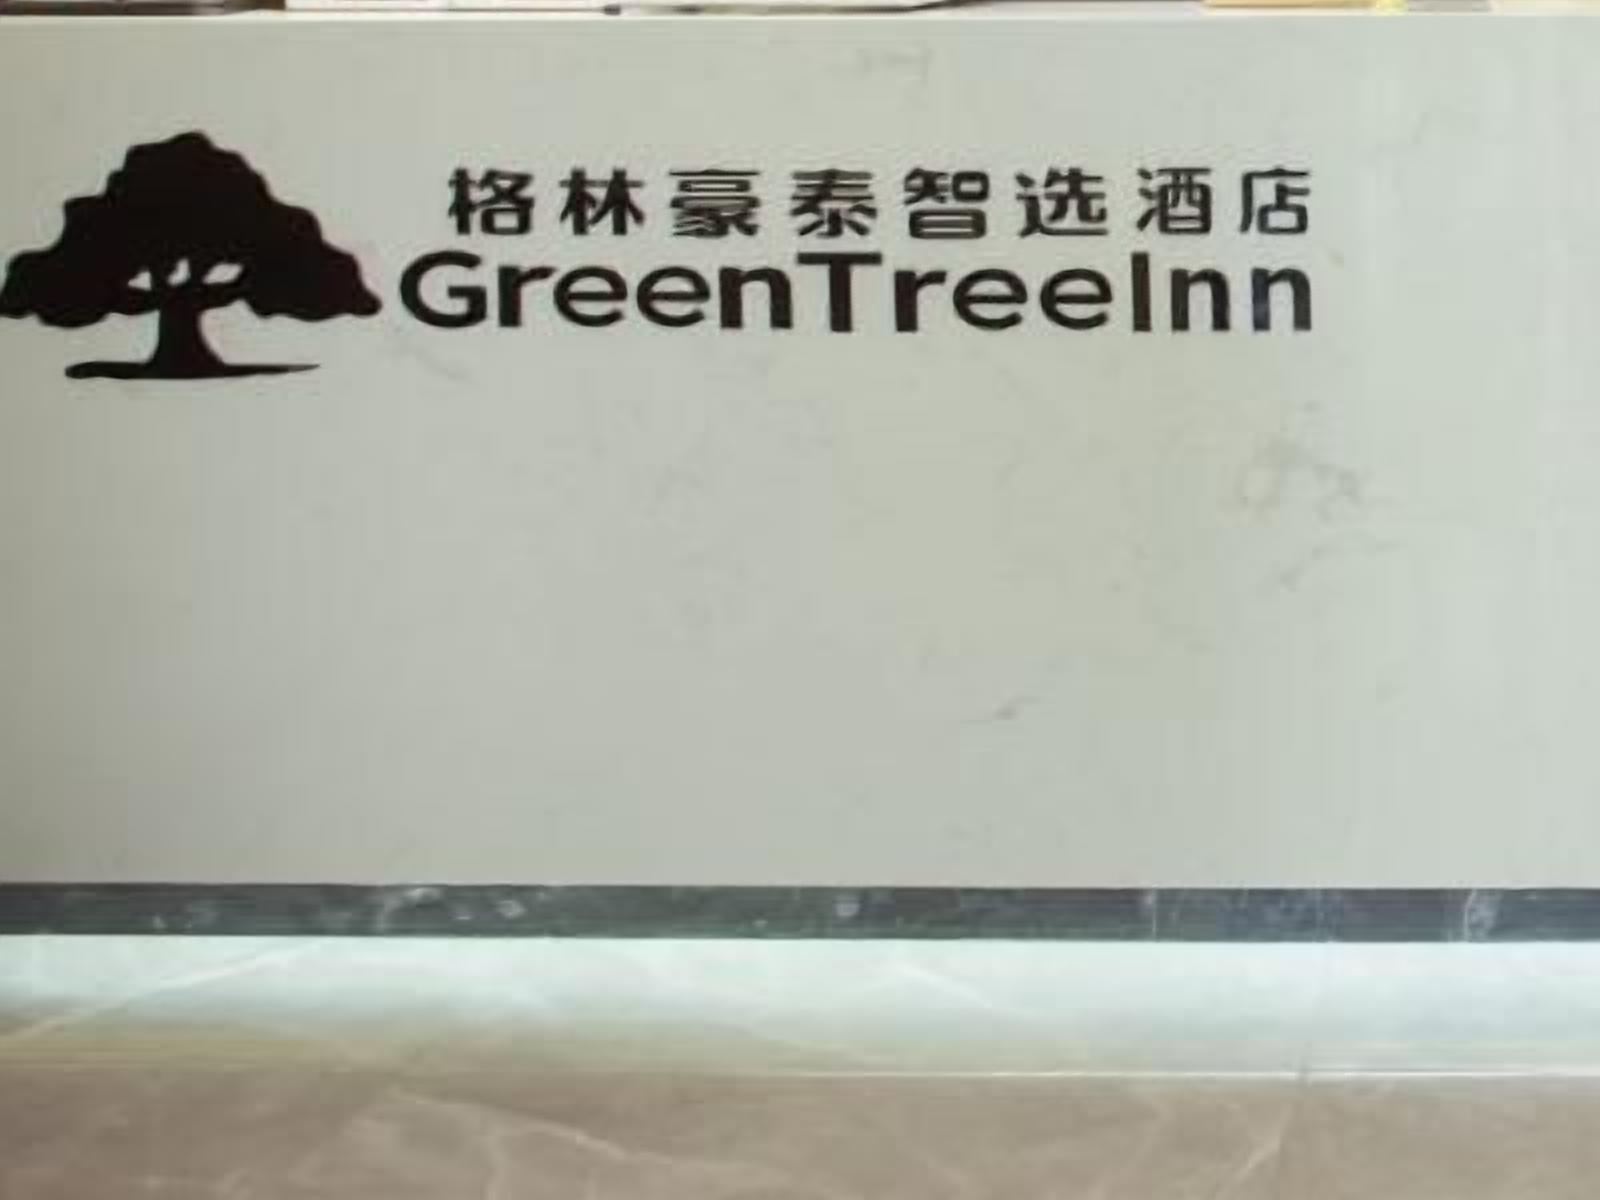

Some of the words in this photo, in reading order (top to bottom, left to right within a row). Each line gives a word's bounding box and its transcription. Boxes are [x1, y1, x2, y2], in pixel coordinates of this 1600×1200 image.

[447, 167, 1310, 239] 格林豪泰智选酒店
[399, 250, 1312, 332] GreenTreeInn
